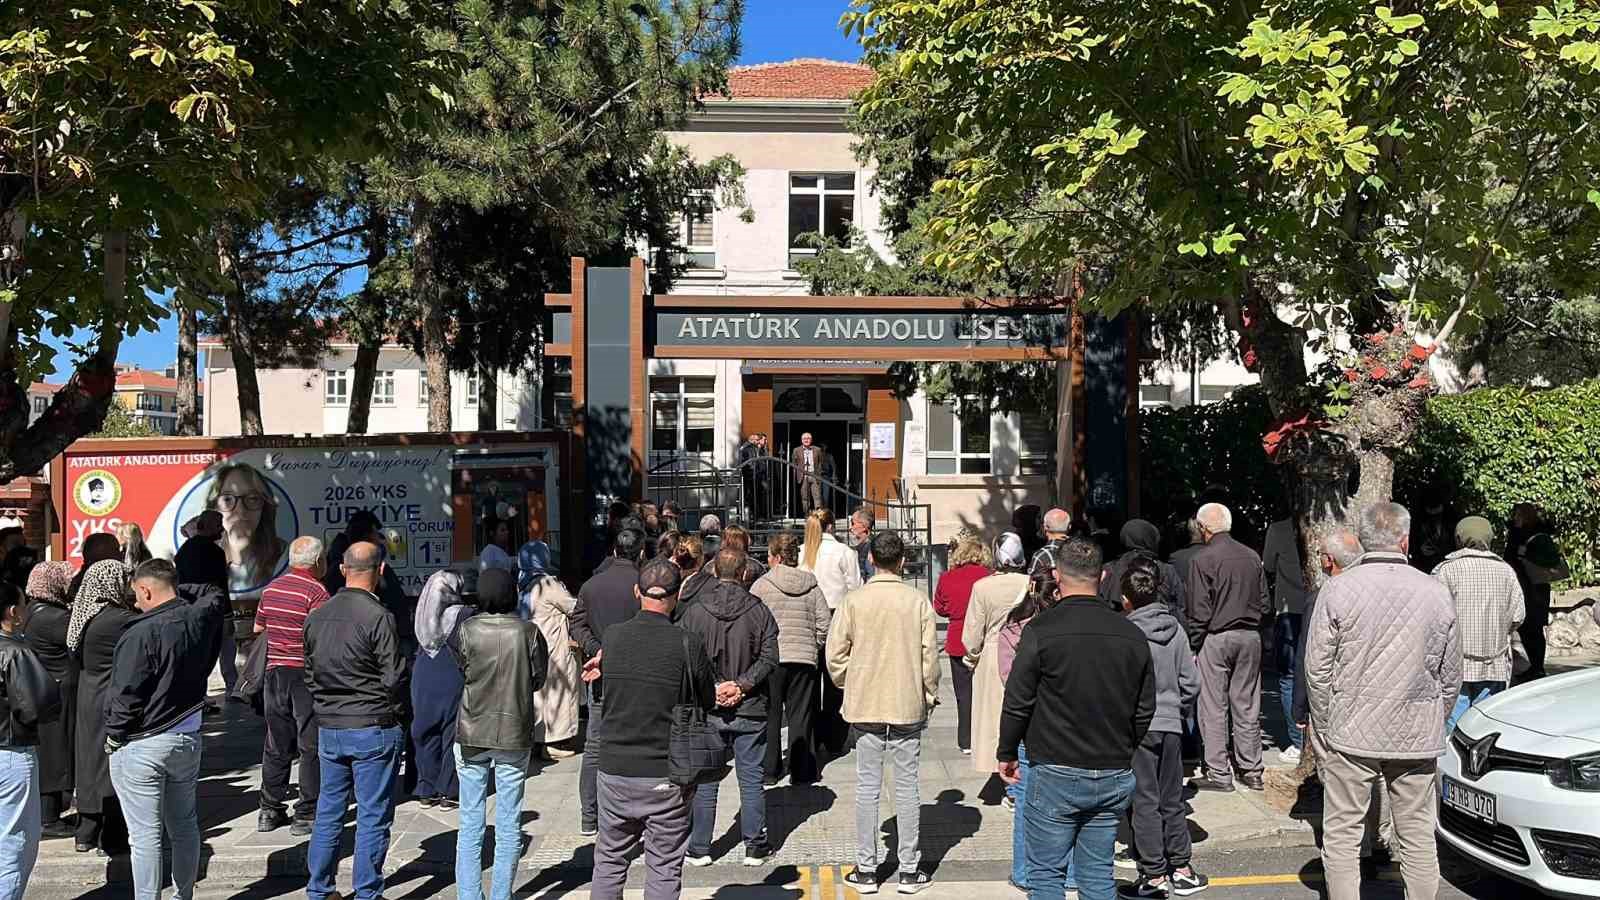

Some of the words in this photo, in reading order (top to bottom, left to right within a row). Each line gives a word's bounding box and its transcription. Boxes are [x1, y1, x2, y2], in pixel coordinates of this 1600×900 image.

[677, 313, 801, 339] ATATÜRK
[813, 318, 944, 340] ANADOLU
[124, 455, 181, 466] ANADOLU
[264, 452, 321, 471] Gurur
[324, 486, 366, 501] 2026
[370, 484, 408, 499] YKS
[1474, 793, 1493, 816] 070
